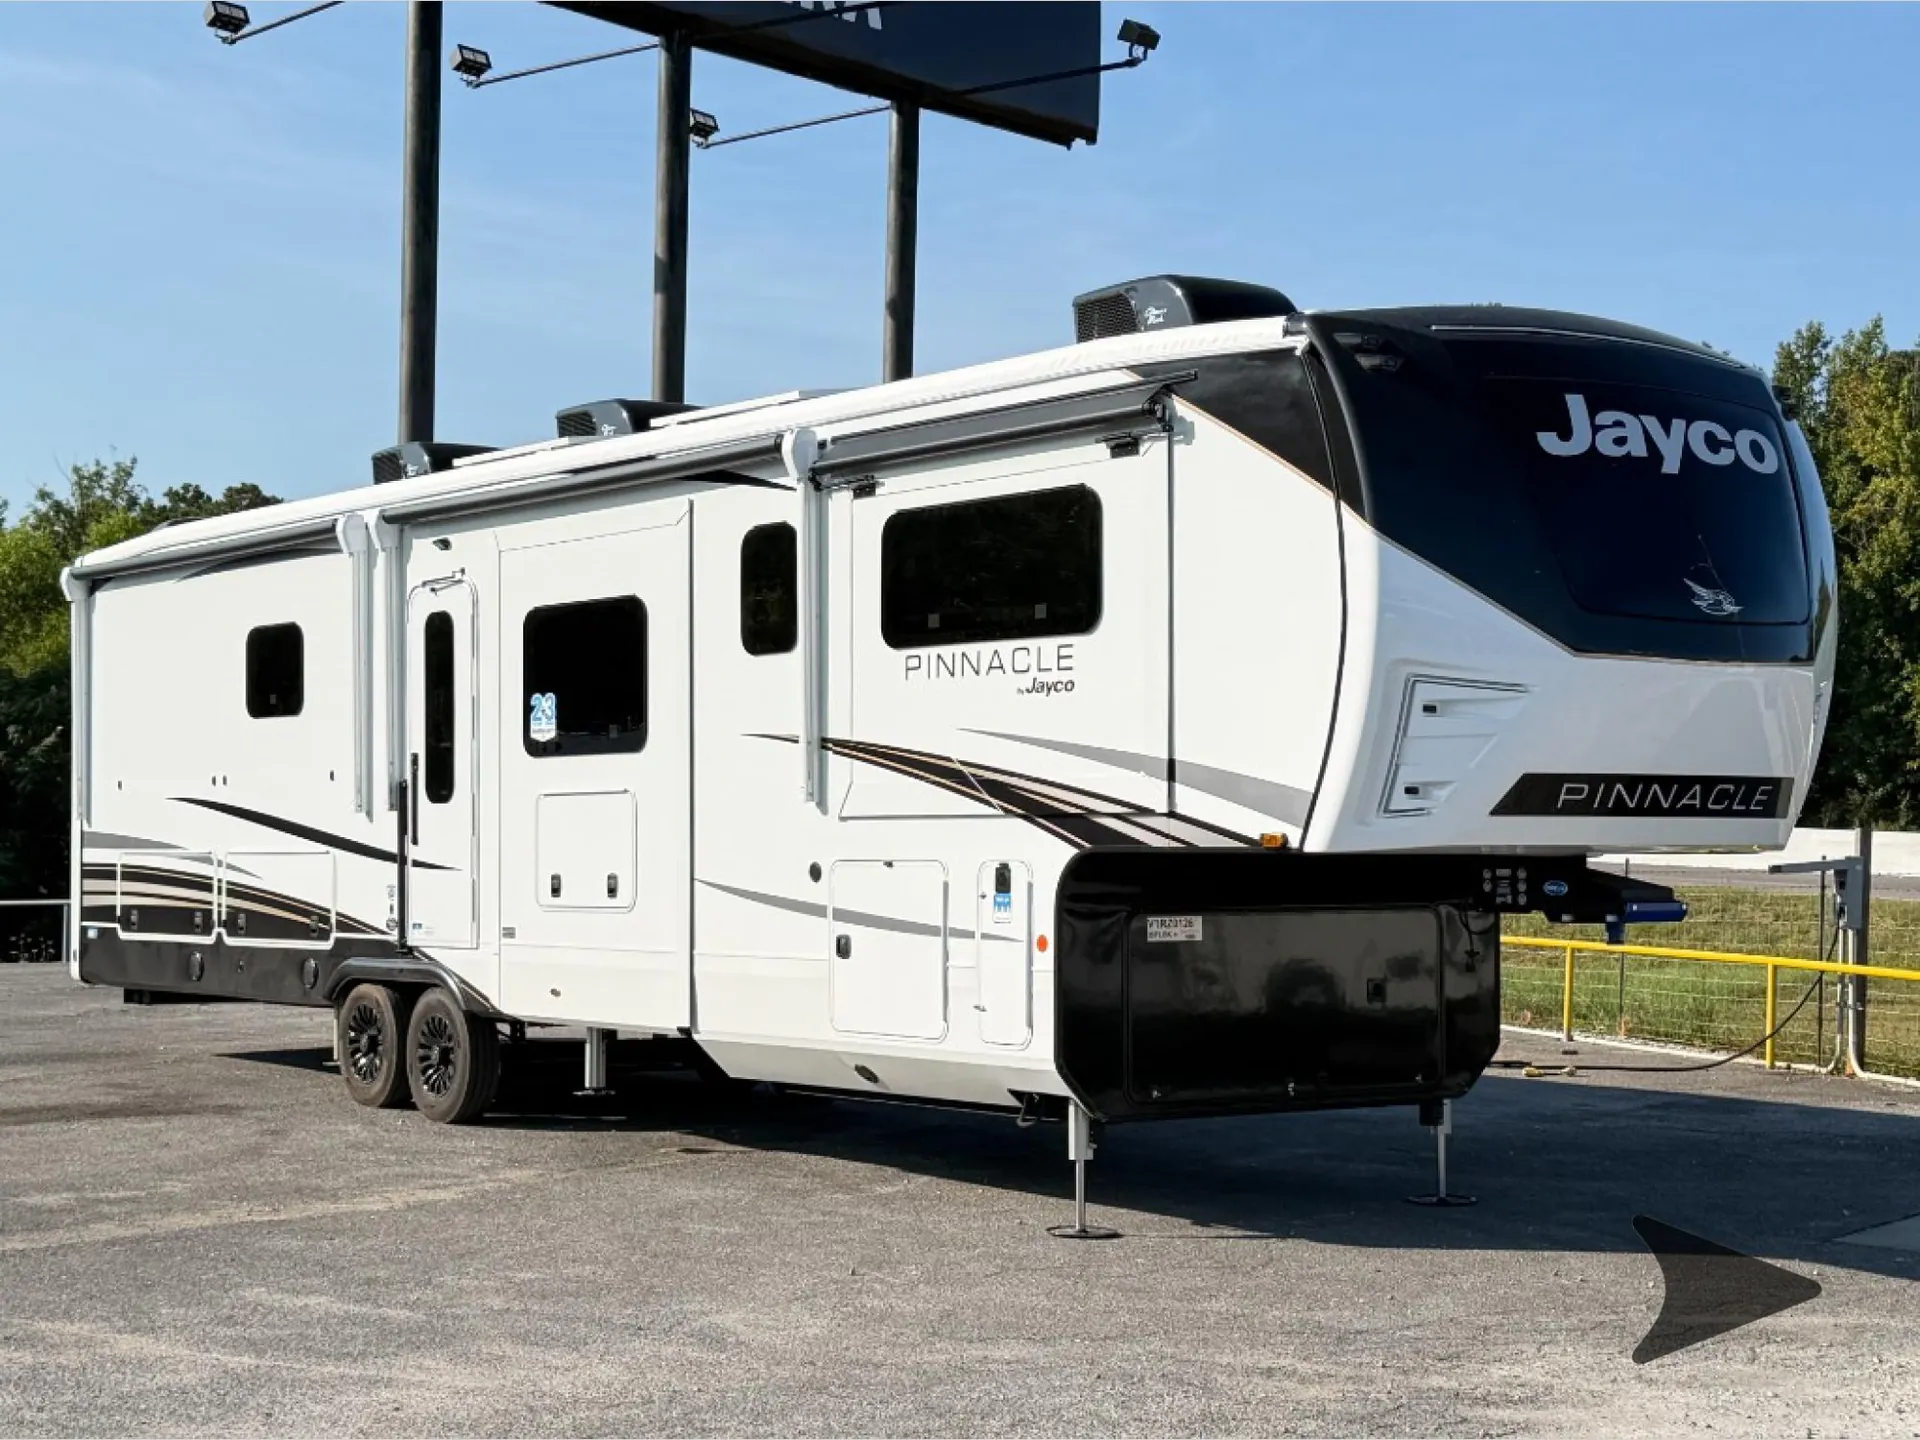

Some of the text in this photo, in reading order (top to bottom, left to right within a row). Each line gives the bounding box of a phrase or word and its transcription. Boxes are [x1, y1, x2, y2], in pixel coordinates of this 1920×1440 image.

[1536, 393, 1778, 474] Jayco
[905, 644, 1074, 681] PINNACLE
[1025, 677, 1075, 697] Jayco
[1557, 782, 1773, 810] PINNACLE
